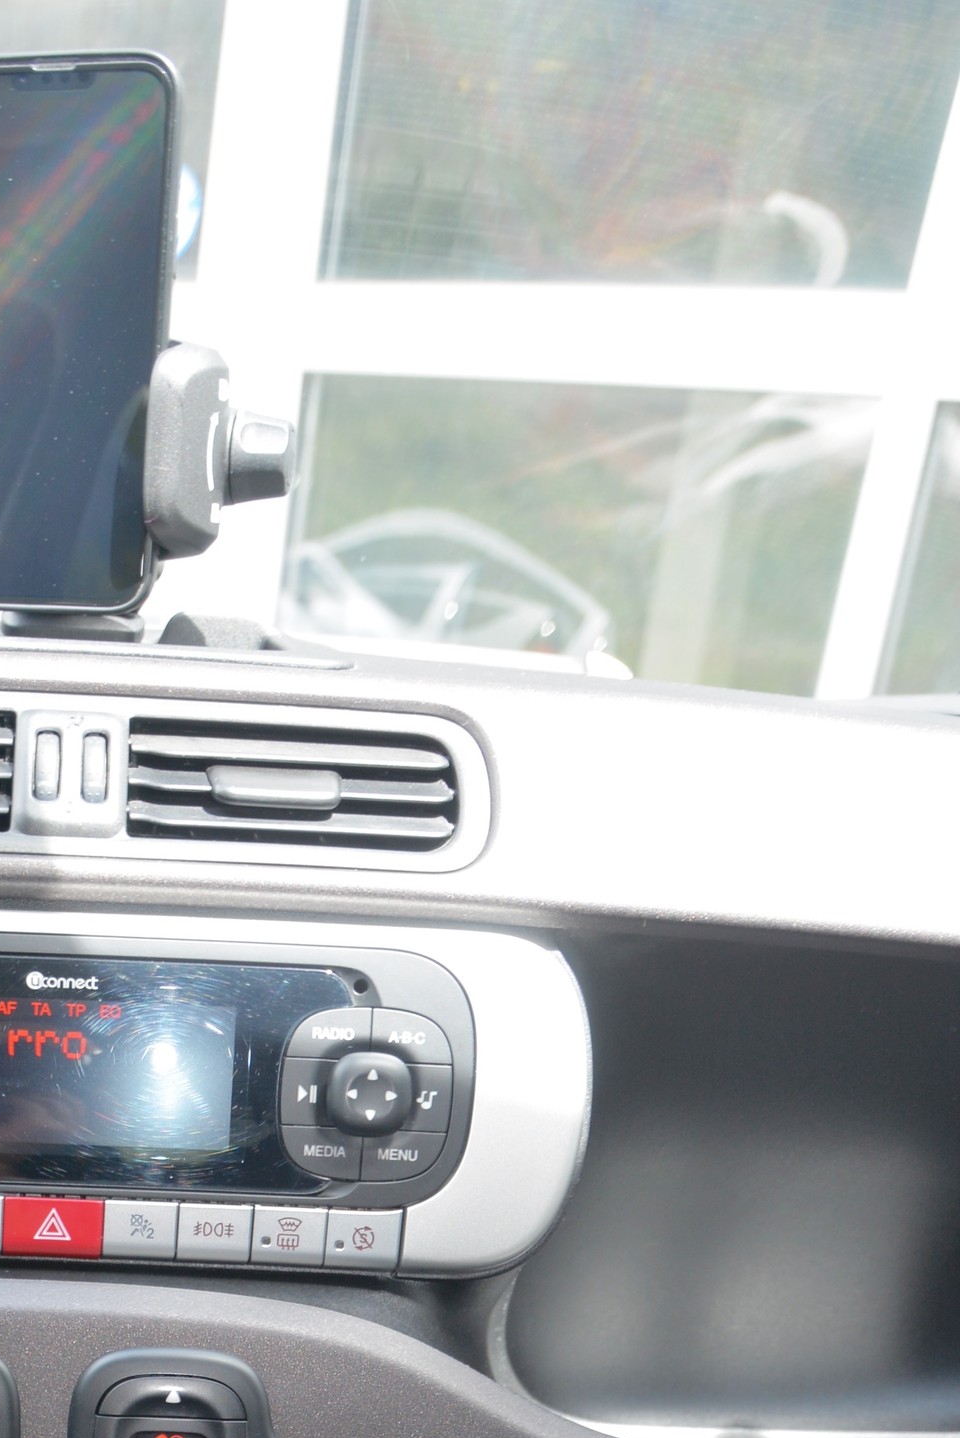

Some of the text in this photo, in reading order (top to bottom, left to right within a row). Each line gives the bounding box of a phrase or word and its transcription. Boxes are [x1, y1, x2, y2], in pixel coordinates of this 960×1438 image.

[31, 1002, 52, 1017] TA
[66, 1003, 87, 1018] TP
[312, 1026, 356, 1041] RADIO
[303, 1144, 347, 1158] MEDIA
[377, 1148, 419, 1162] MENU
